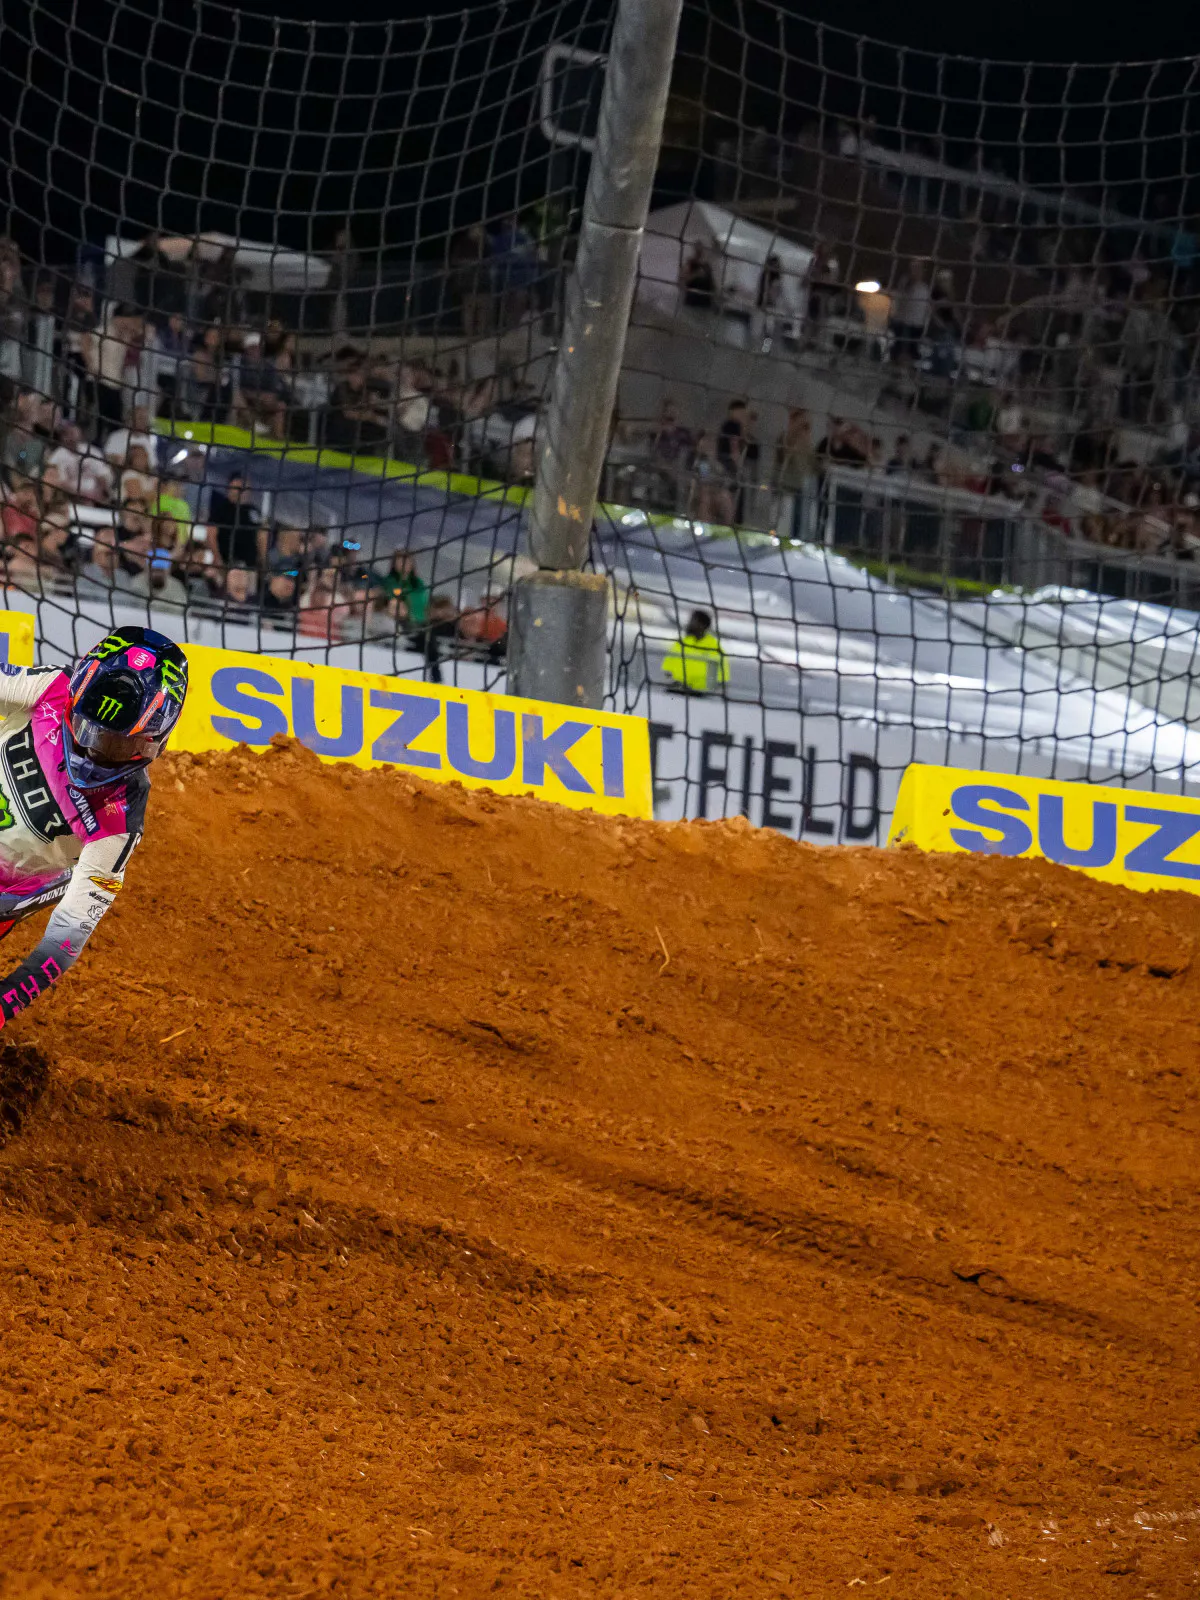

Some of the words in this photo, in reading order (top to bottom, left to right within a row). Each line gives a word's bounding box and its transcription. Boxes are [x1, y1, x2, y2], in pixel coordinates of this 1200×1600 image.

[210, 667, 625, 798] SUZUKI
[75, 796, 97, 833] YAMAHA
[701, 731, 880, 840] FIELD
[38, 884, 70, 905] DUNLO
